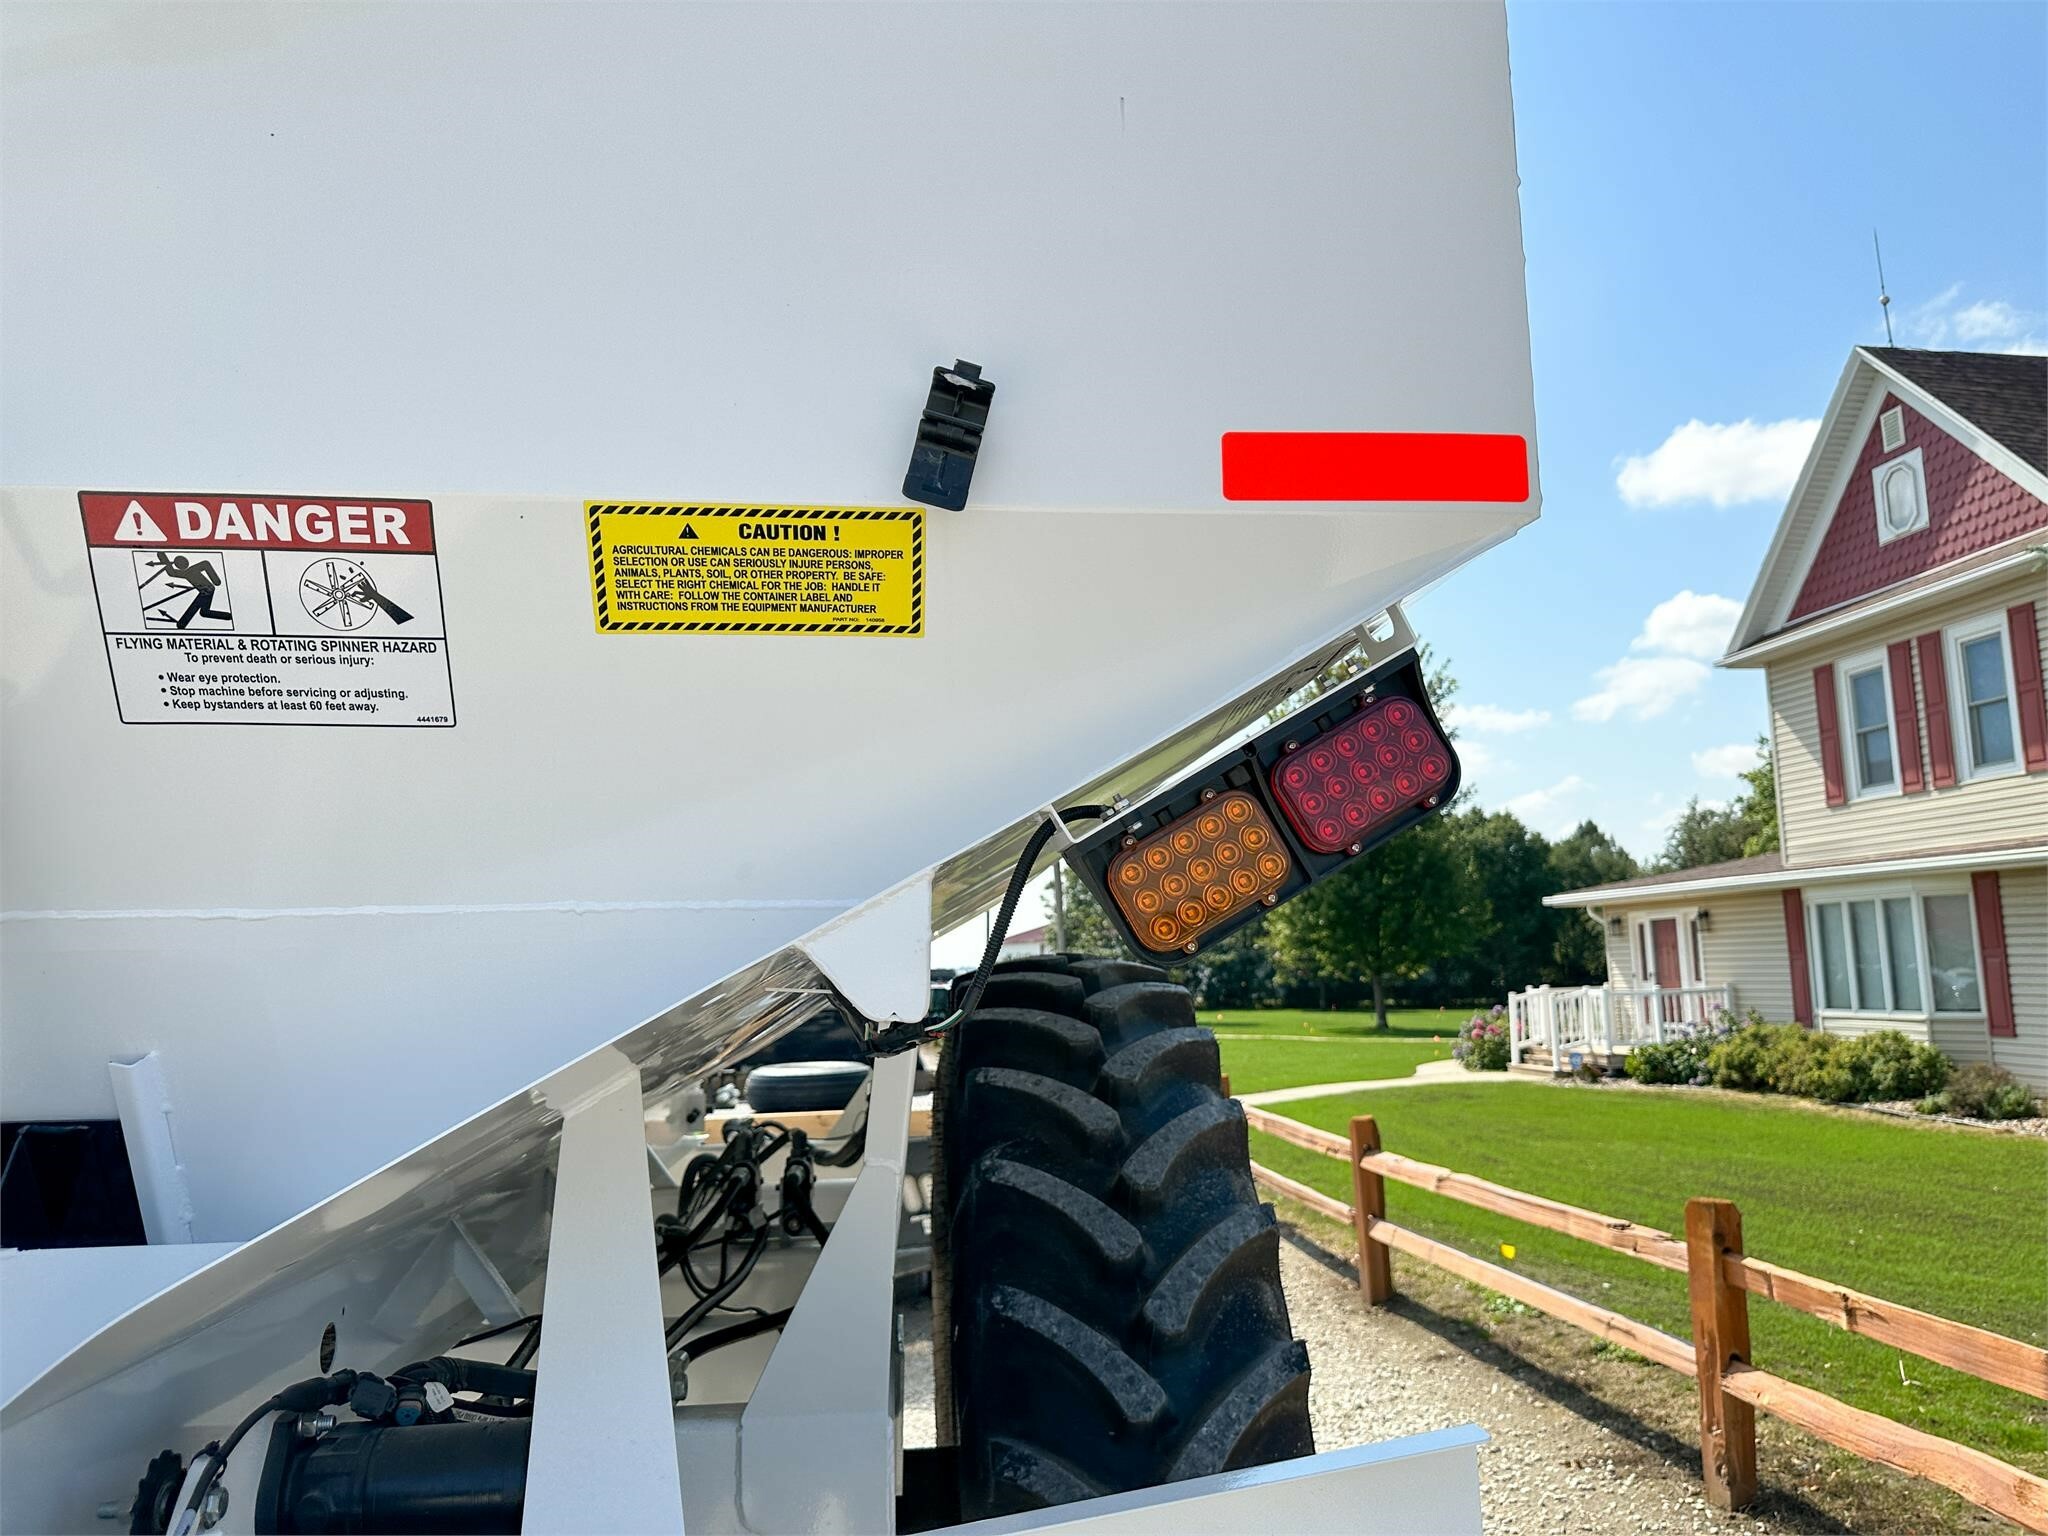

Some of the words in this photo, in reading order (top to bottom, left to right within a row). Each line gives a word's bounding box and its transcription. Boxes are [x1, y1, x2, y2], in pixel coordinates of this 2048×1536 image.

[174, 502, 411, 544] DANGER
[738, 523, 826, 540] CAUTION
[834, 526, 840, 541] !
[612, 545, 688, 555] AGRICULTURAL
[690, 546, 747, 556] CHEMICALS
[750, 547, 770, 556] CAN
[773, 548, 786, 557] BE
[788, 549, 852, 558] DANGEROUS:
[854, 550, 904, 559] IMPROPER
[613, 557, 668, 566] SELECTION
[670, 558, 685, 566] OR
[688, 558, 707, 567] USE
[710, 558, 730, 567] CAN
[733, 558, 786, 568] SERIOUSLY
[789, 560, 823, 569] INJURE
[826, 561, 874, 571] PERSONS,
[614, 568, 660, 578] ANIMALS,
[664, 569, 704, 579] PLANTS,
[706, 570, 731, 579] SOIL,
[734, 570, 748, 579] OR
[750, 570, 783, 579] OTHER
[786, 571, 838, 580] PROPERTY.
[844, 572, 856, 580] BE
[858, 572, 886, 581] SAFE:
[616, 580, 653, 588] SELECT
[656, 580, 674, 589] THE
[678, 580, 706, 589] RIGHT
[709, 581, 759, 590] CHEMICAL
[762, 582, 780, 590] FOR
[783, 582, 802, 590] THE
[804, 582, 826, 591] JOB:
[831, 583, 870, 592] HANDLE
[872, 583, 880, 592] IT
[616, 590, 640, 600] WITH
[643, 591, 673, 600] CARE:
[678, 591, 719, 600] FOLLOW
[722, 592, 740, 600] THE
[743, 592, 797, 601] CONTAINER
[800, 593, 831, 602] LABEL
[833, 593, 852, 602] AND
[617, 602, 688, 611] INSTRUCTIONS
[691, 602, 718, 611] FROM
[721, 603, 739, 611] THE
[743, 603, 797, 612] EQUIPMENT
[800, 604, 876, 613] MANUFACTURER
[116, 638, 162, 649] FLYING
[167, 638, 234, 650] MATERIAL
[238, 639, 247, 650] &
[251, 640, 316, 651] ROTATING
[321, 641, 379, 652] SPINNER
[383, 641, 436, 653] HAZARD
[184, 653, 198, 662] To
[202, 653, 244, 664] prevent
[246, 653, 277, 663] death
[295, 655, 336, 664] serious
[340, 655, 374, 667] injury:
[167, 672, 195, 682] Wear
[199, 675, 218, 684] eye
[222, 673, 280, 684] protection.
[170, 686, 195, 697] Stop
[199, 686, 245, 696] machine
[248, 686, 283, 696] before
[286, 688, 336, 699] servicing
[340, 690, 350, 698] or
[354, 689, 408, 700] adjusting.
[172, 699, 200, 711] Keep
[204, 700, 264, 711] bystanders
[268, 701, 278, 710] at
[281, 700, 307, 710] least
[310, 701, 322, 710] 60
[326, 701, 346, 711] feet
[348, 703, 379, 713] away.
